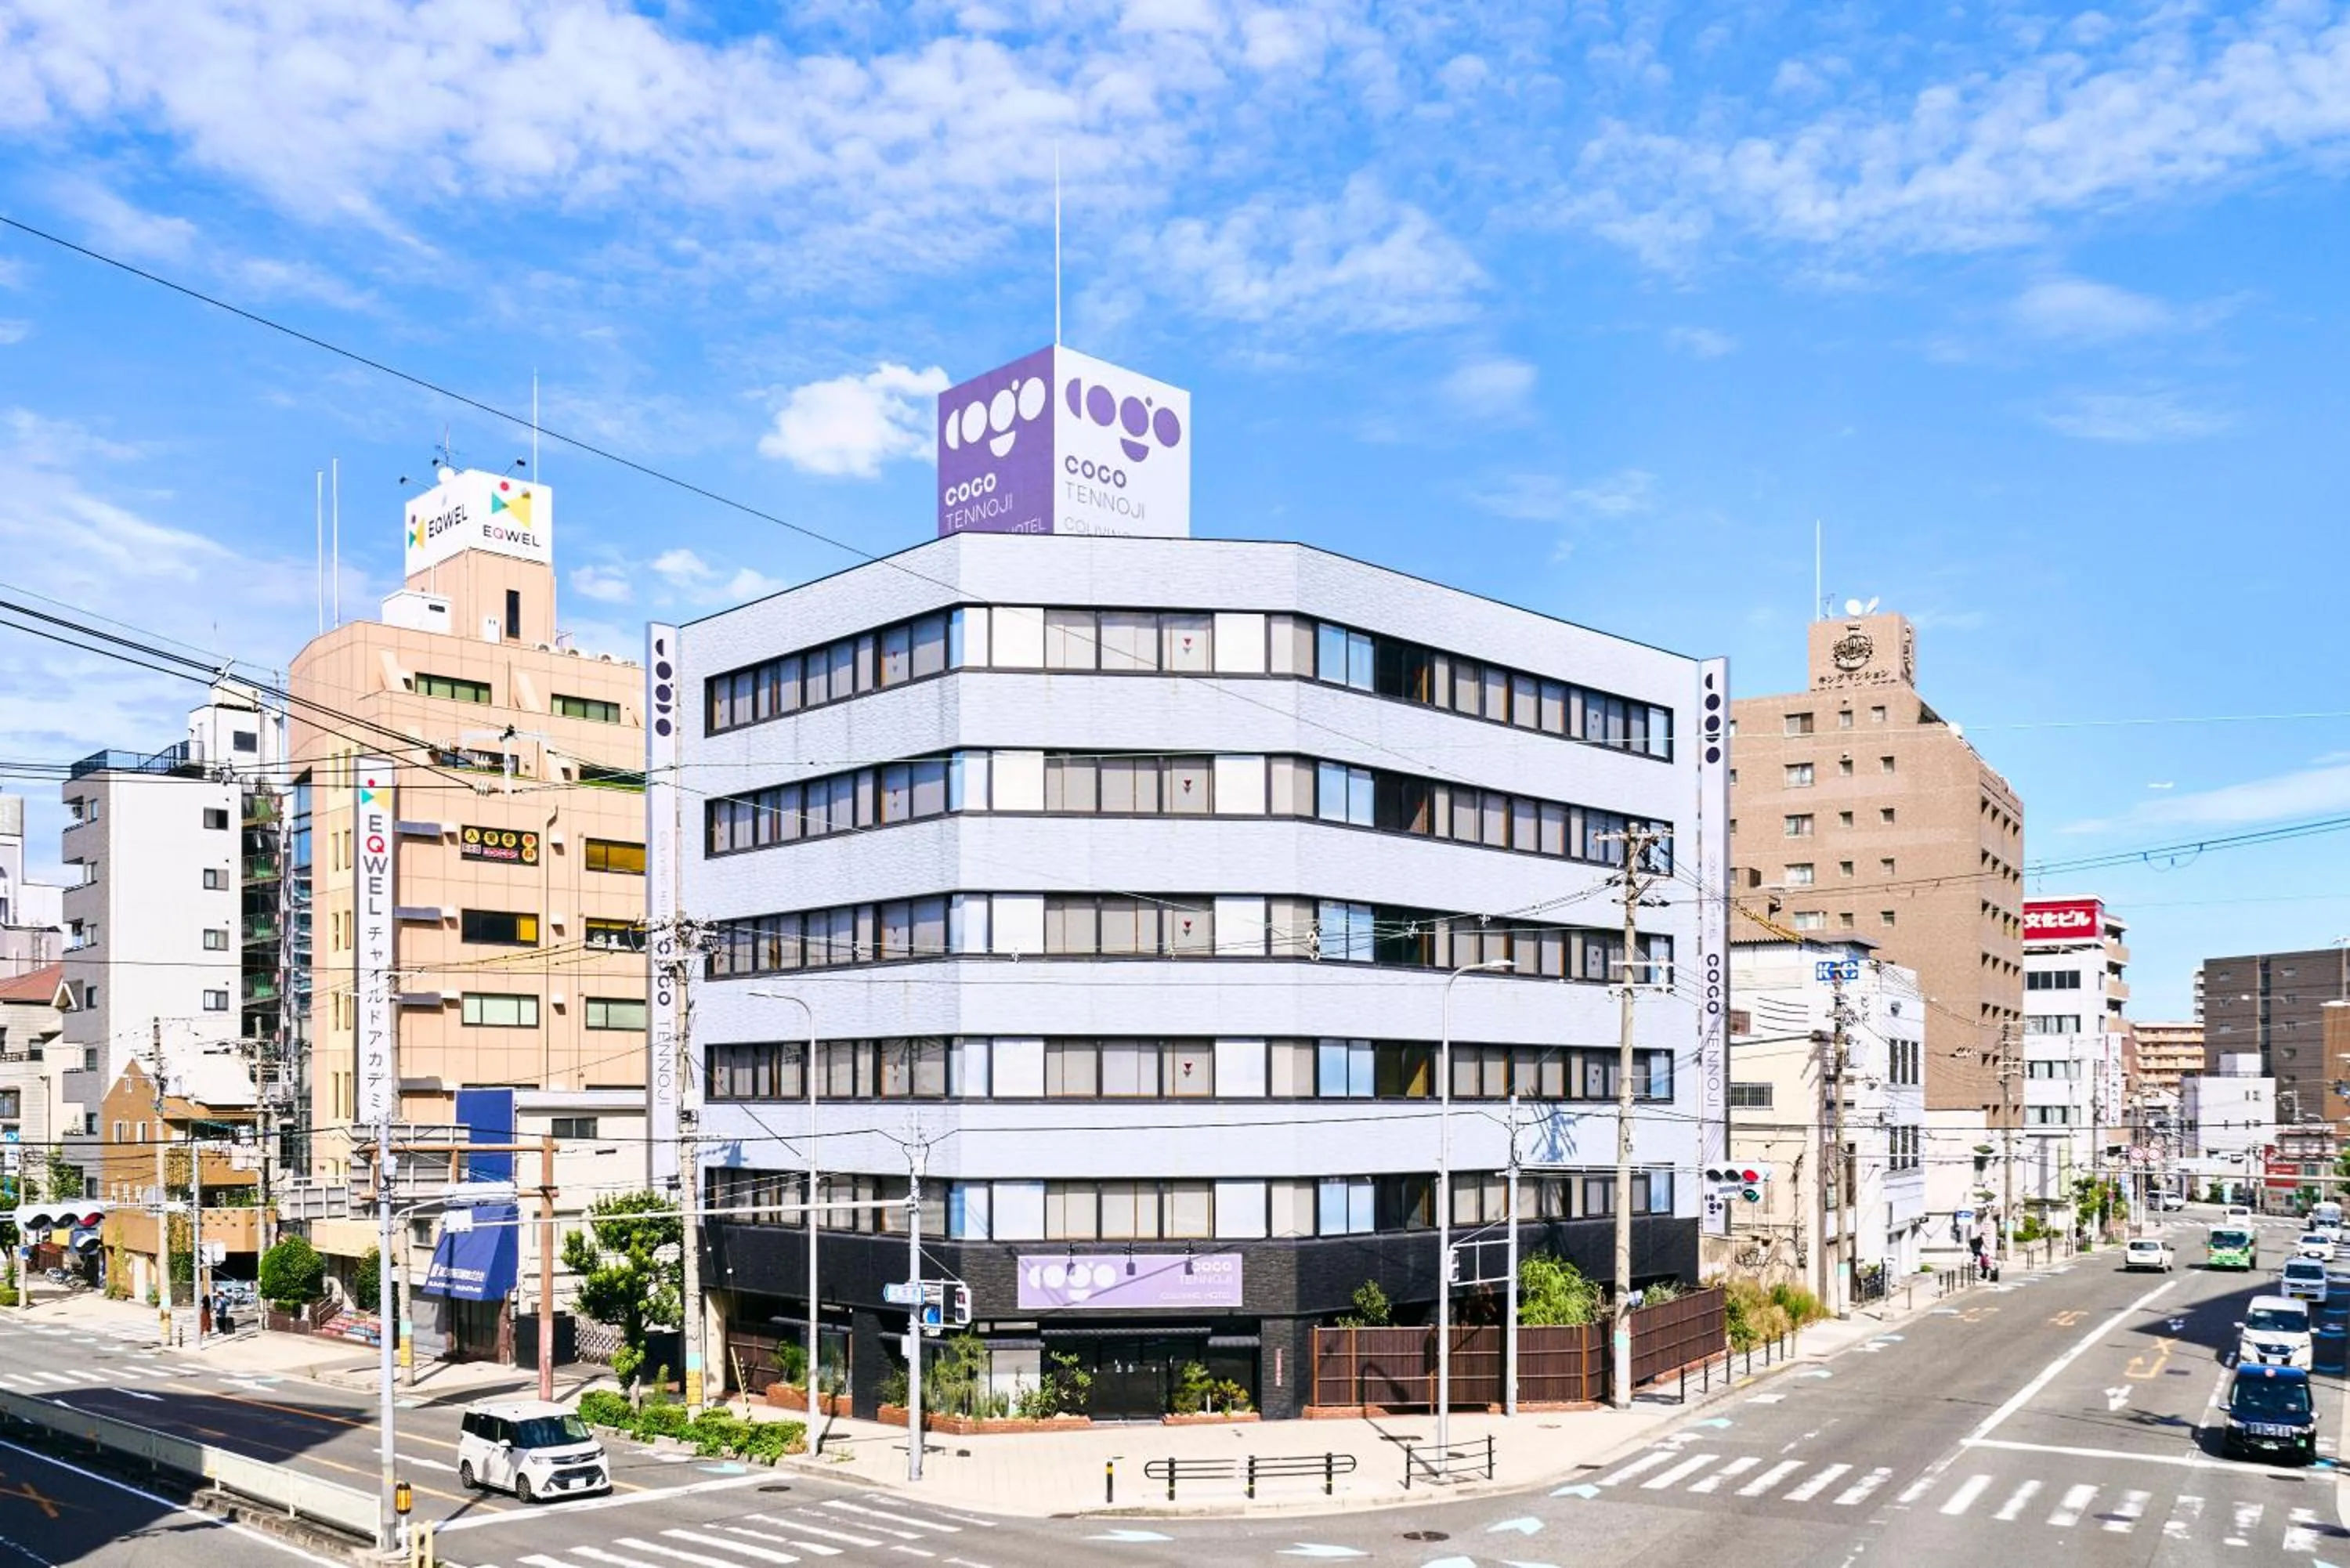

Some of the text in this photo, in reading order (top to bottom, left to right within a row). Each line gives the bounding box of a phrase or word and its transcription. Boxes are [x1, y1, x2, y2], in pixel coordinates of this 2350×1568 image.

[945, 472, 996, 506] COCO
[1065, 455, 1126, 488] COCO
[945, 493, 1013, 531] TENNOJI
[1065, 480, 1144, 519] TENNOJI
[428, 504, 468, 538] EQWEL
[483, 524, 541, 547] EQWEL
[363, 814, 389, 916] EQWEL
[2024, 910, 2092, 930] 文化ビル
[1706, 953, 1719, 1014] COCO
[657, 1021, 671, 1106] TENNOJI
